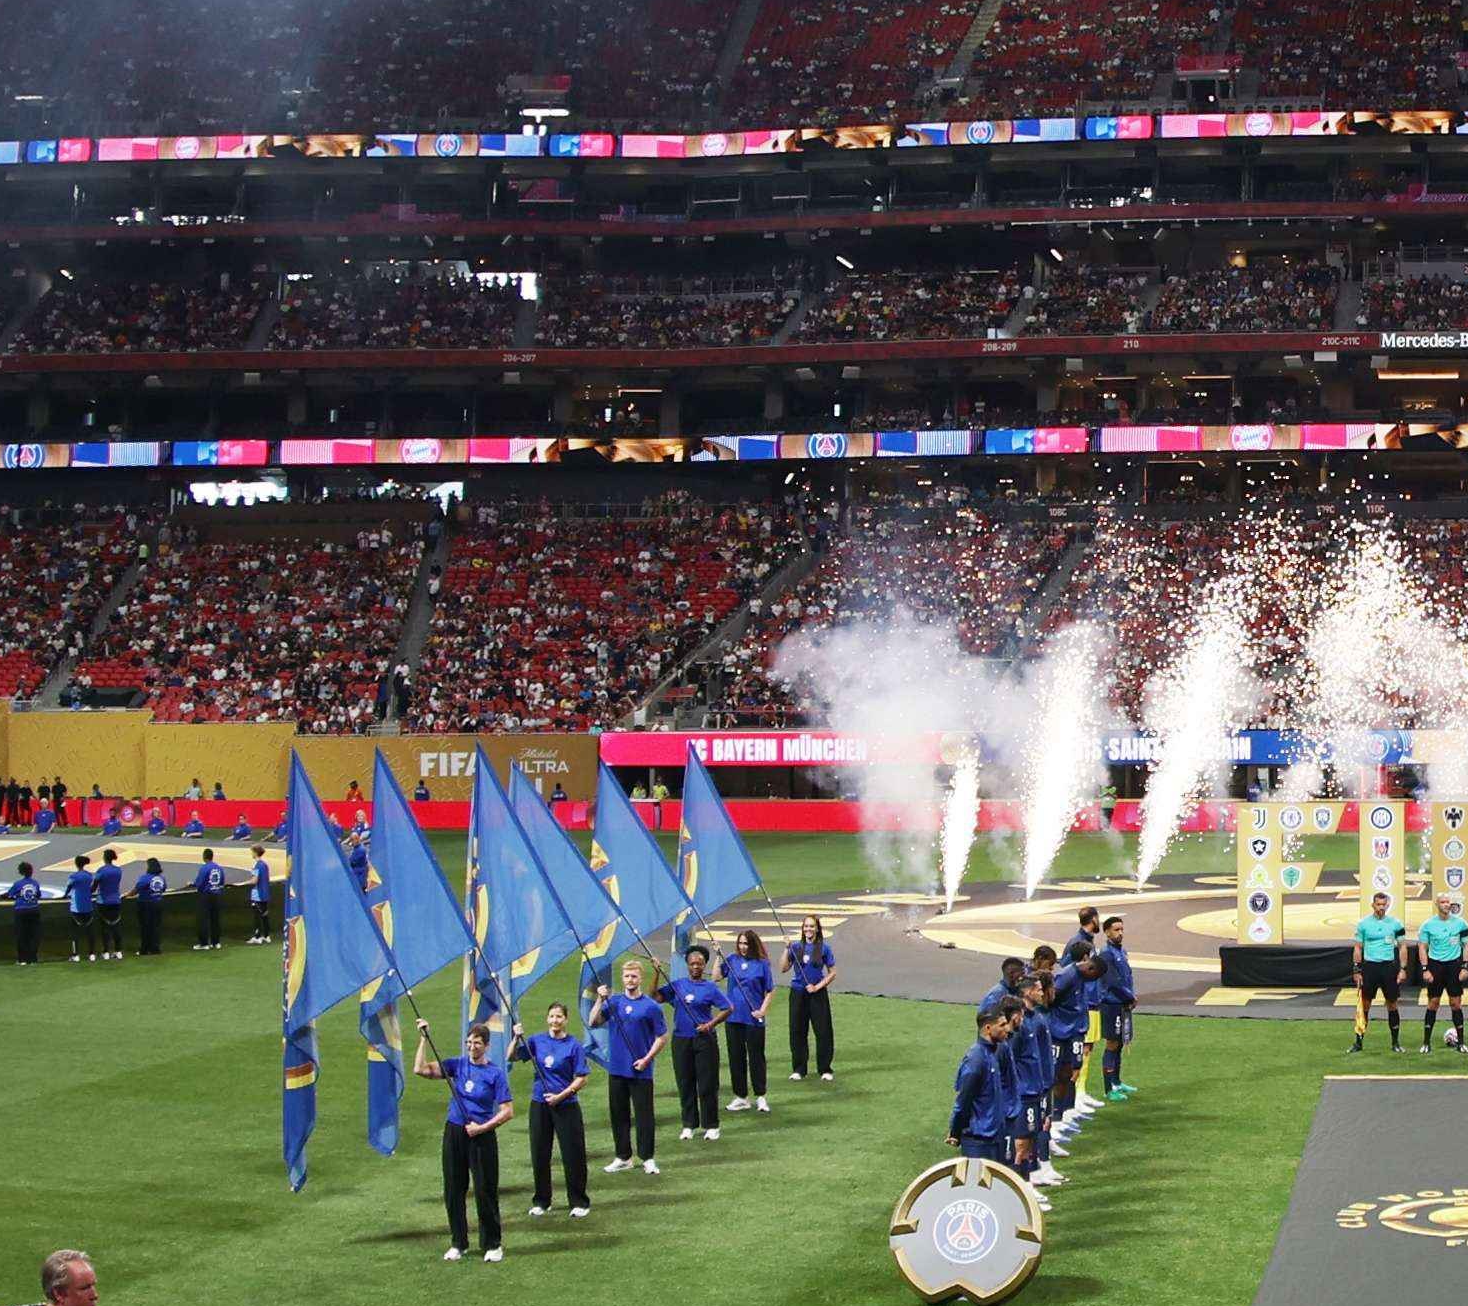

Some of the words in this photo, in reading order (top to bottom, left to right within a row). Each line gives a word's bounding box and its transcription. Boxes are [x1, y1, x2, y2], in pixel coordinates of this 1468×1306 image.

[1123, 339, 1139, 349] 210
[1322, 336, 1360, 346] 210C-211C
[1366, 504, 1384, 514] 110C
[712, 737, 777, 762] BAYERN
[783, 734, 867, 762] MÜNCHEN
[1026, 1108, 1035, 1123] 8
[946, 1202, 989, 1220] PARIS
[1335, 1201, 1377, 1230] CLUB
